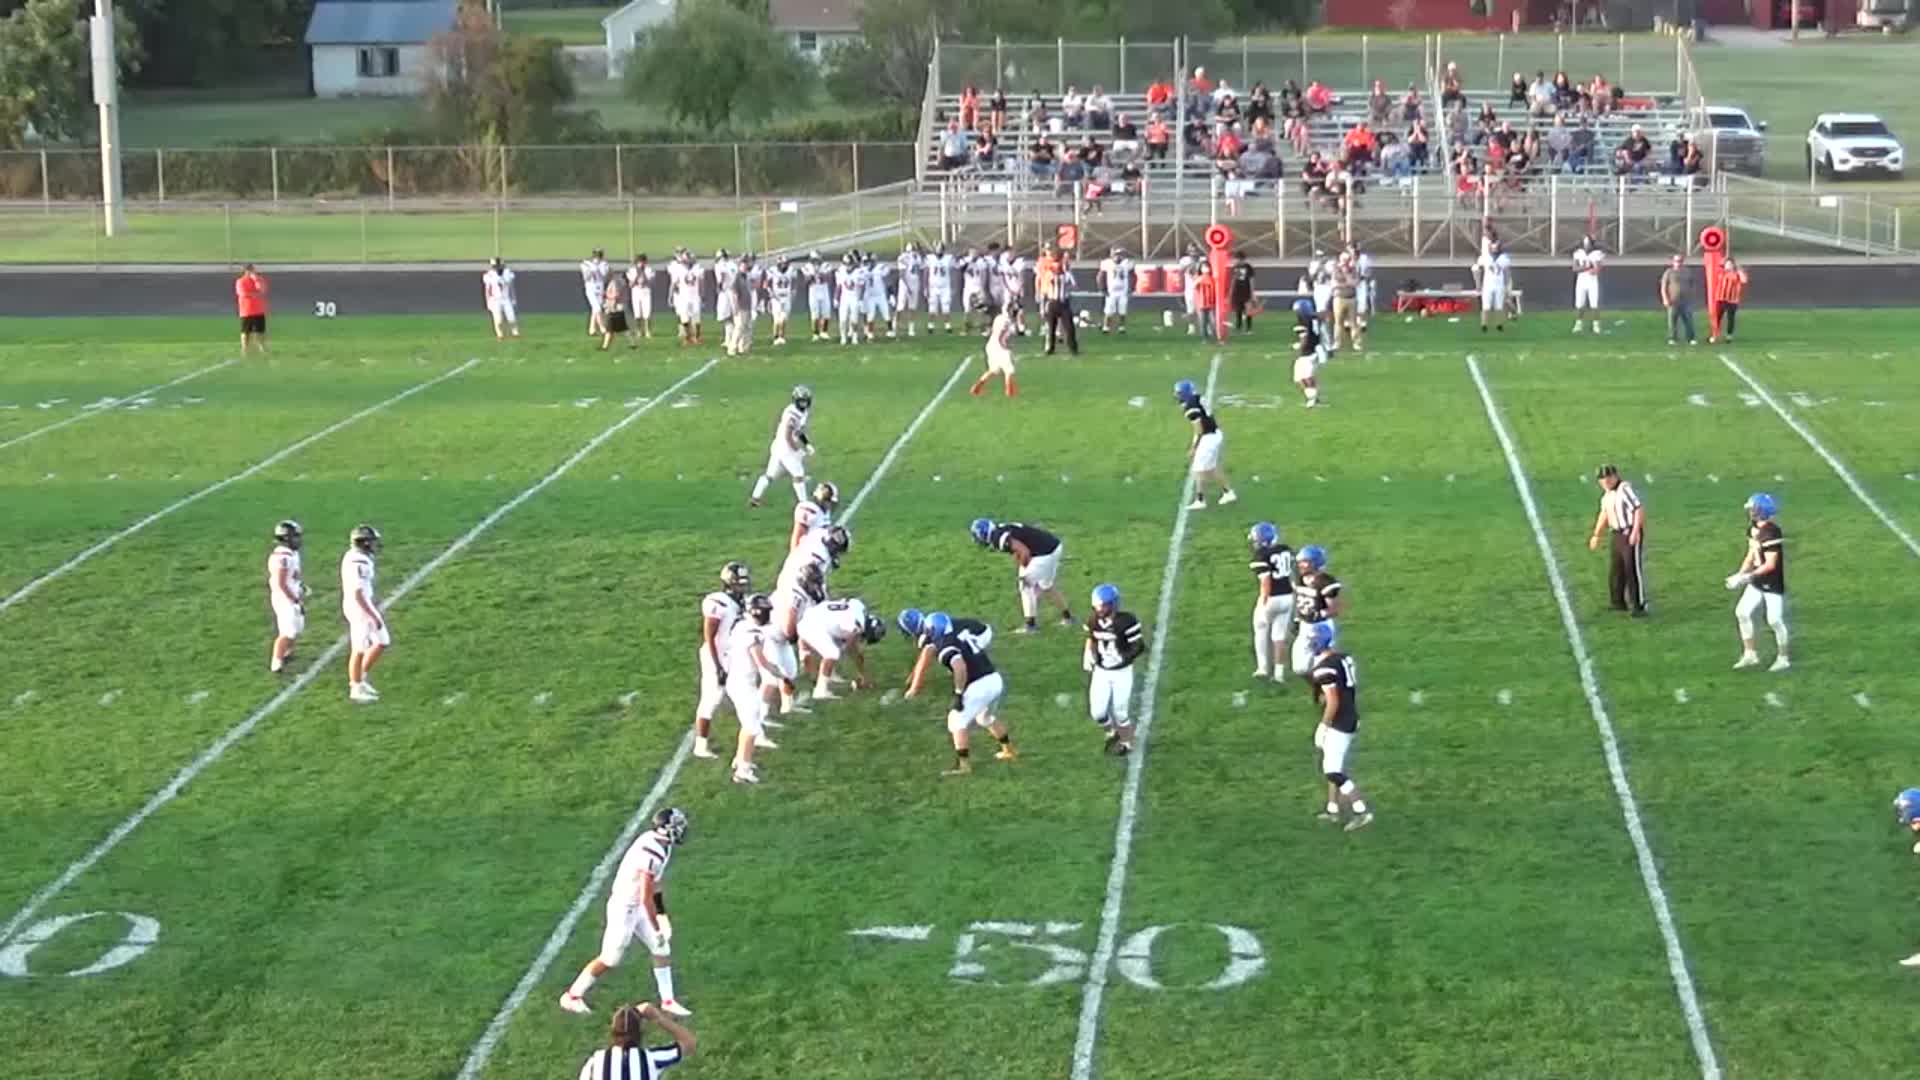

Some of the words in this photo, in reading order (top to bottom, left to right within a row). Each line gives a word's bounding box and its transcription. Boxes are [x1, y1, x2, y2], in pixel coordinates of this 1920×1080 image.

[1059, 226, 1075, 248] 2
[315, 302, 337, 316] 30
[1270, 552, 1291, 579] 30
[948, 922, 1267, 990] 50
